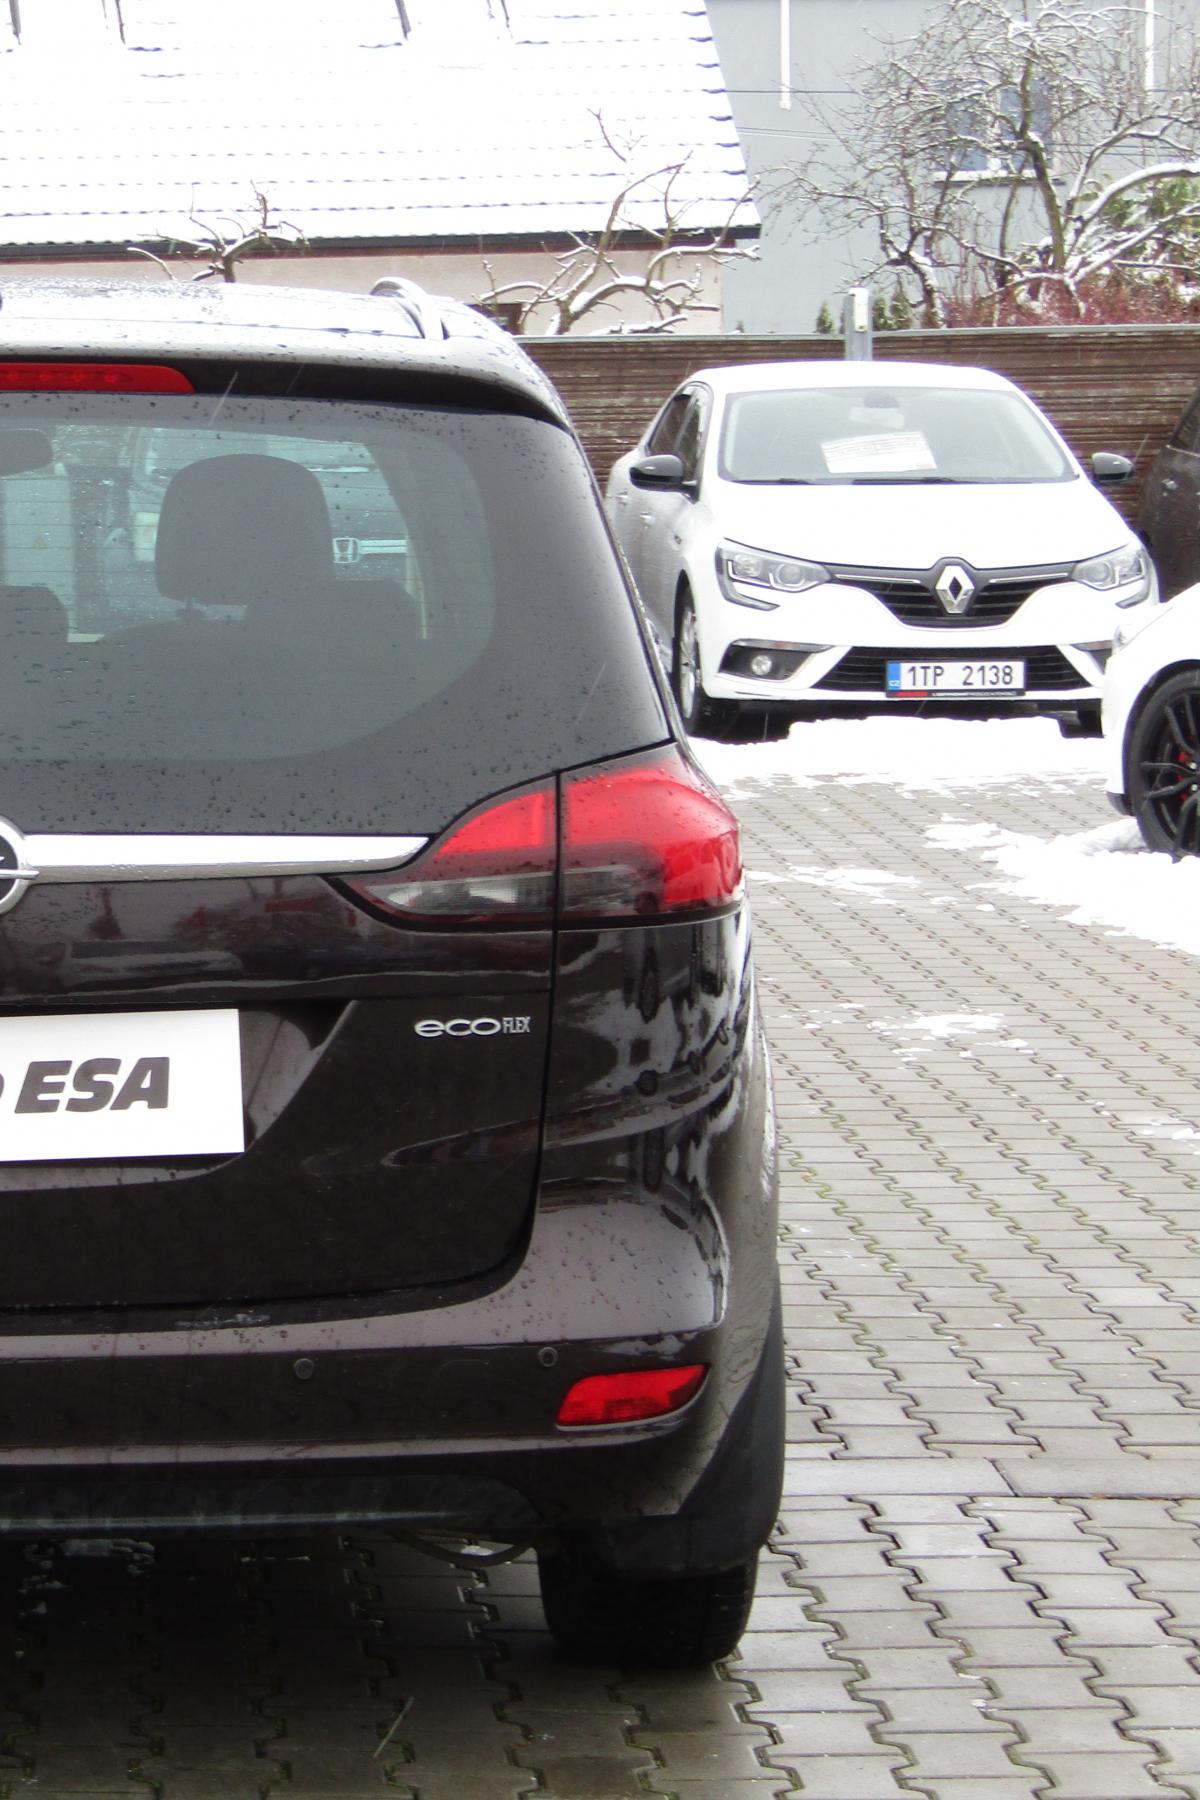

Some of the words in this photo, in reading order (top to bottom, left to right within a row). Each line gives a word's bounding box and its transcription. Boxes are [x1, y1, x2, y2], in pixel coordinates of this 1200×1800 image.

[907, 665, 944, 687] 1TP
[962, 664, 1013, 686] 2138
[14, 1056, 170, 1115] ESA
